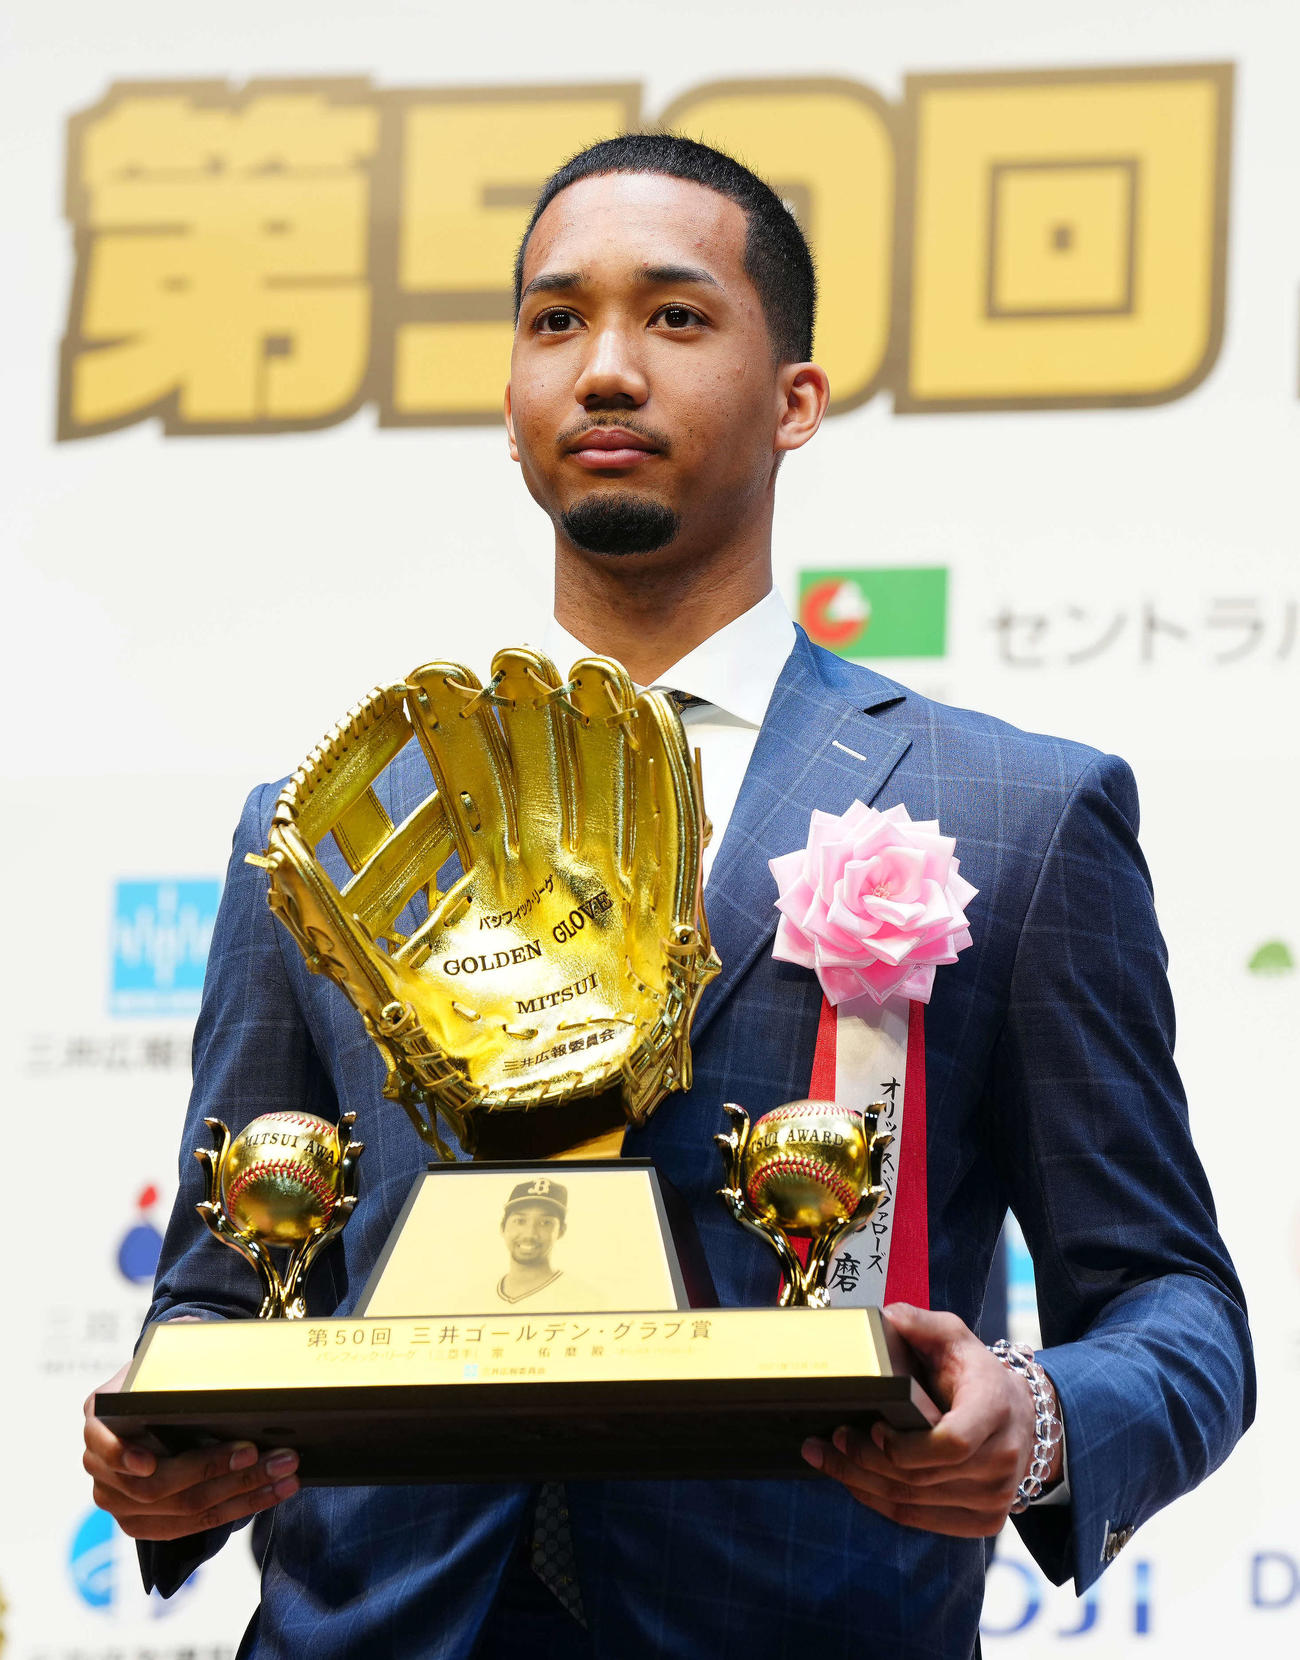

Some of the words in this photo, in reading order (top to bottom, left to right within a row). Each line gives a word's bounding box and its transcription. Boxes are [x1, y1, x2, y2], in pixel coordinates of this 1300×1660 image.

[56, 62, 1237, 442] 第50回
[443, 938, 543, 976] GOLDEN
[552, 891, 615, 944] GLOVE
[515, 973, 599, 1015] MITSUI
[502, 1028, 616, 1072] 三井広報委員会
[244, 1132, 300, 1148] MITSUI
[303, 1139, 342, 1170] AWA
[786, 1128, 844, 1147] AWARD
[307, 1327, 392, 1348] 第50回
[410, 1319, 713, 1345] 三井ゴールデン・グラブ賞
